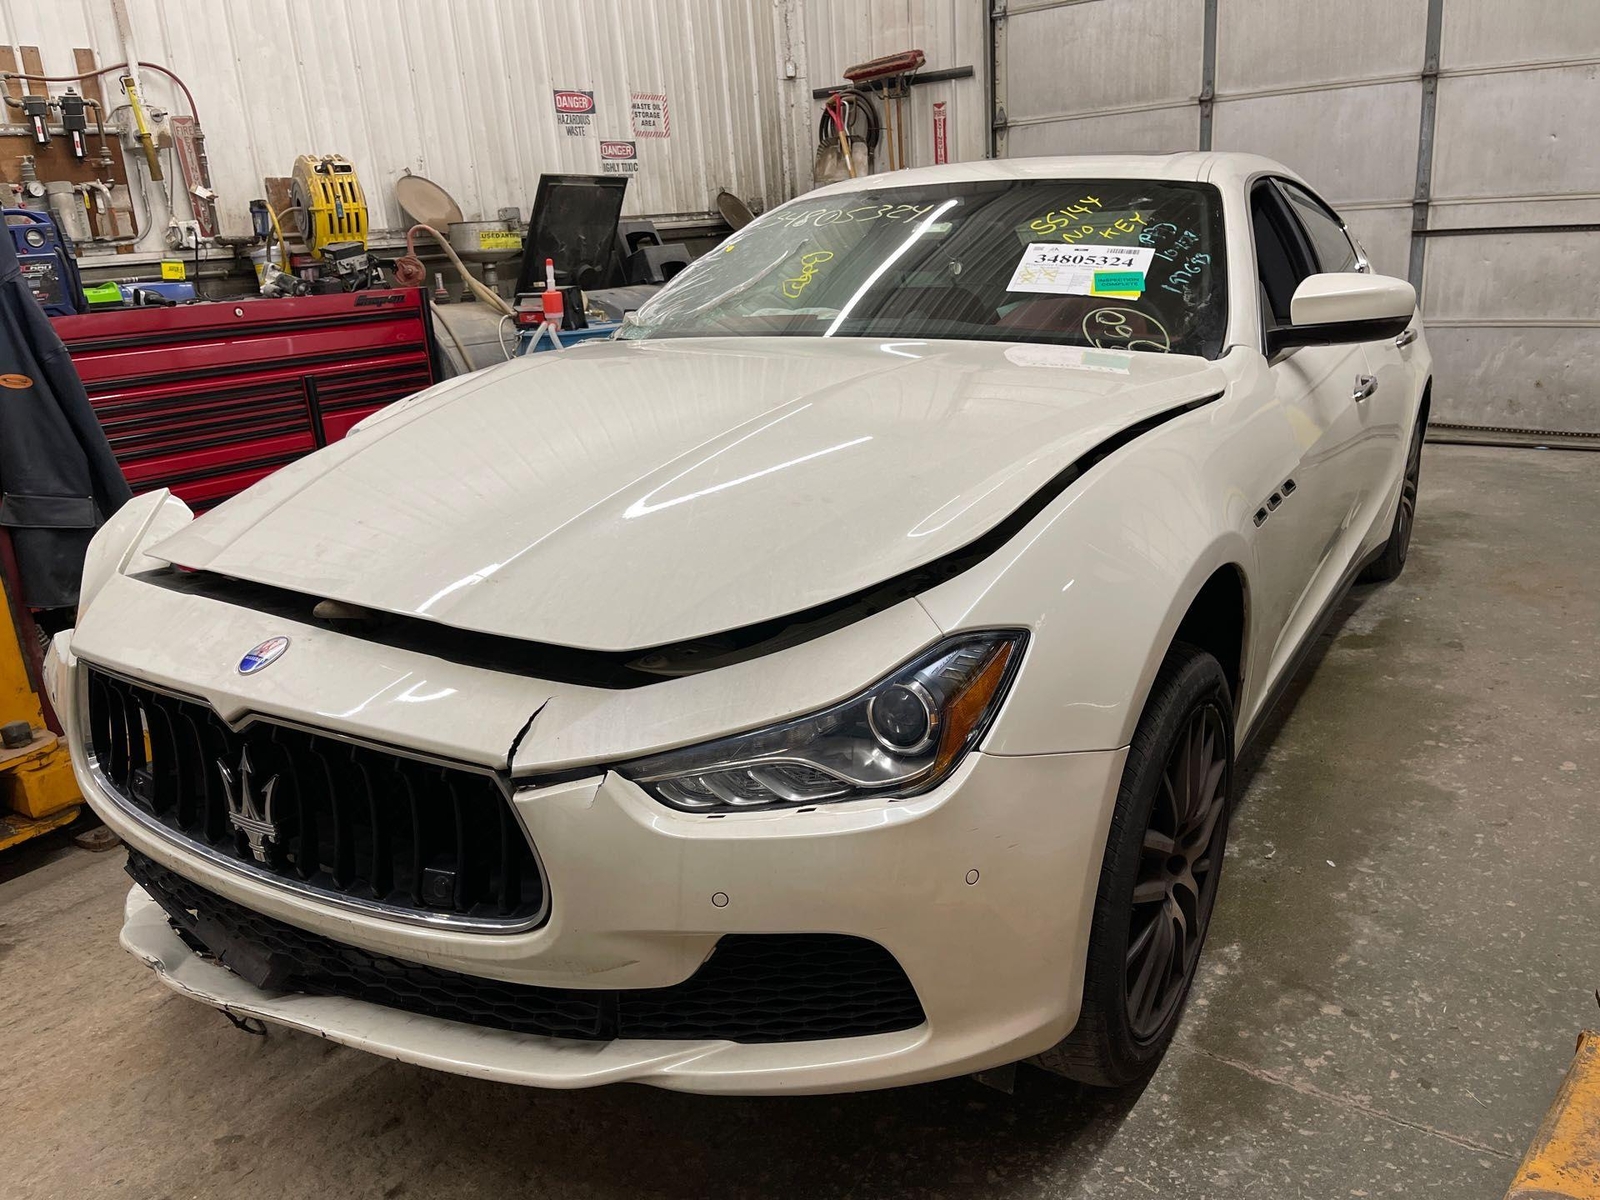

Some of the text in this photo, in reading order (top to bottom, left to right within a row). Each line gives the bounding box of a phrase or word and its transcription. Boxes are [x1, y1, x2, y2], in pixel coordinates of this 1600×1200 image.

[556, 96, 588, 109] DANGER
[557, 115, 591, 125] HAZARDOUS
[175, 125, 195, 137] FIRE
[566, 126, 586, 136] WASTE
[602, 145, 632, 156] DANGER
[602, 163, 639, 172] IGHLY TOXIC
[1062, 225, 1094, 244] NO
[1099, 211, 1148, 240] KEY
[1034, 254, 1134, 267] 34805324
